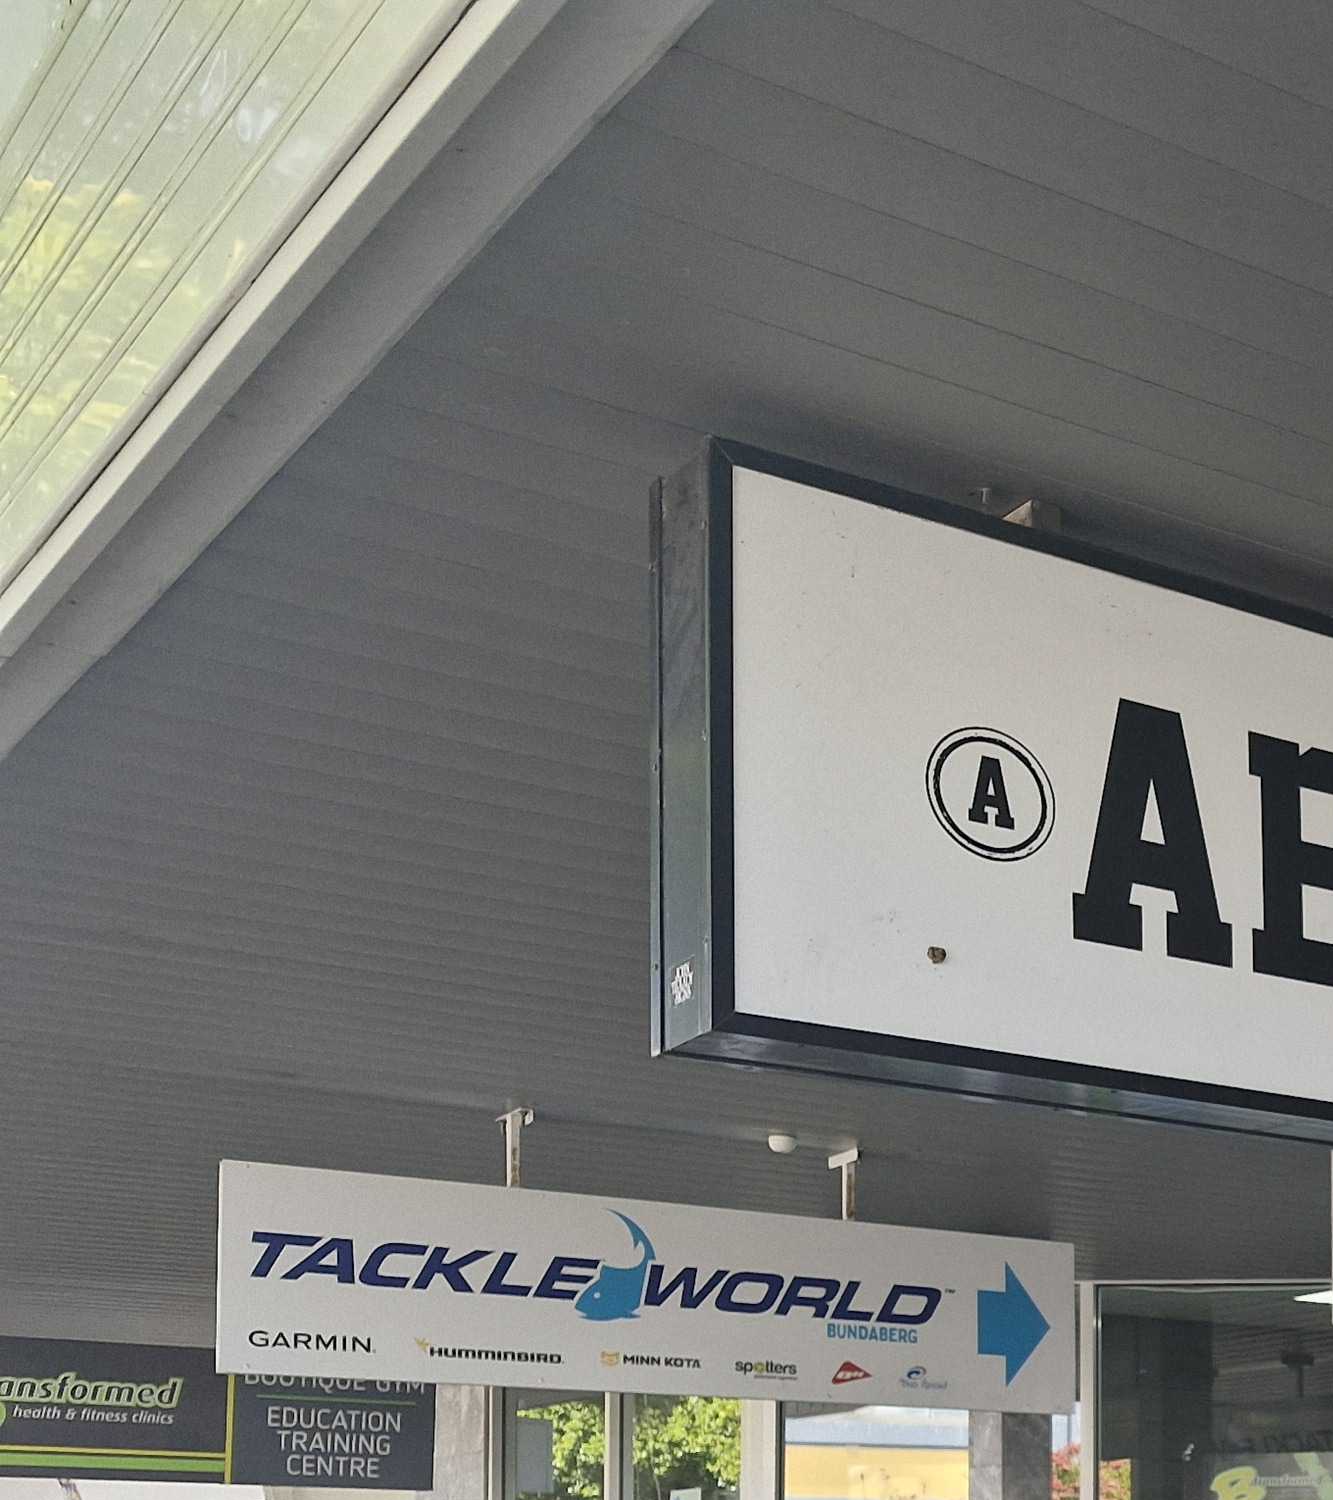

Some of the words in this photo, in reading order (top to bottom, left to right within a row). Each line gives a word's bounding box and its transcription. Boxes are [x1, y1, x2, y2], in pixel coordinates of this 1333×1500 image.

[967, 757, 1014, 831] A
[250, 1231, 600, 1302] TACKLE
[644, 1264, 942, 1325] WORLD
[248, 1330, 372, 1353] GARMIN
[827, 1323, 918, 1344] BUNDABERG
[430, 1346, 562, 1365] HUMMINBIRD
[623, 1354, 660, 1367] MINN
[664, 1357, 701, 1369] KOTA
[735, 1361, 798, 1377] spotters
[12, 1404, 61, 1421] health
[65, 1408, 76, 1421] &
[80, 1408, 127, 1424] fitness
[132, 1411, 175, 1425] clinics
[267, 1405, 402, 1433] EDUCATION
[277, 1429, 391, 1456] TRAINING
[286, 1454, 380, 1478] CENTRE
